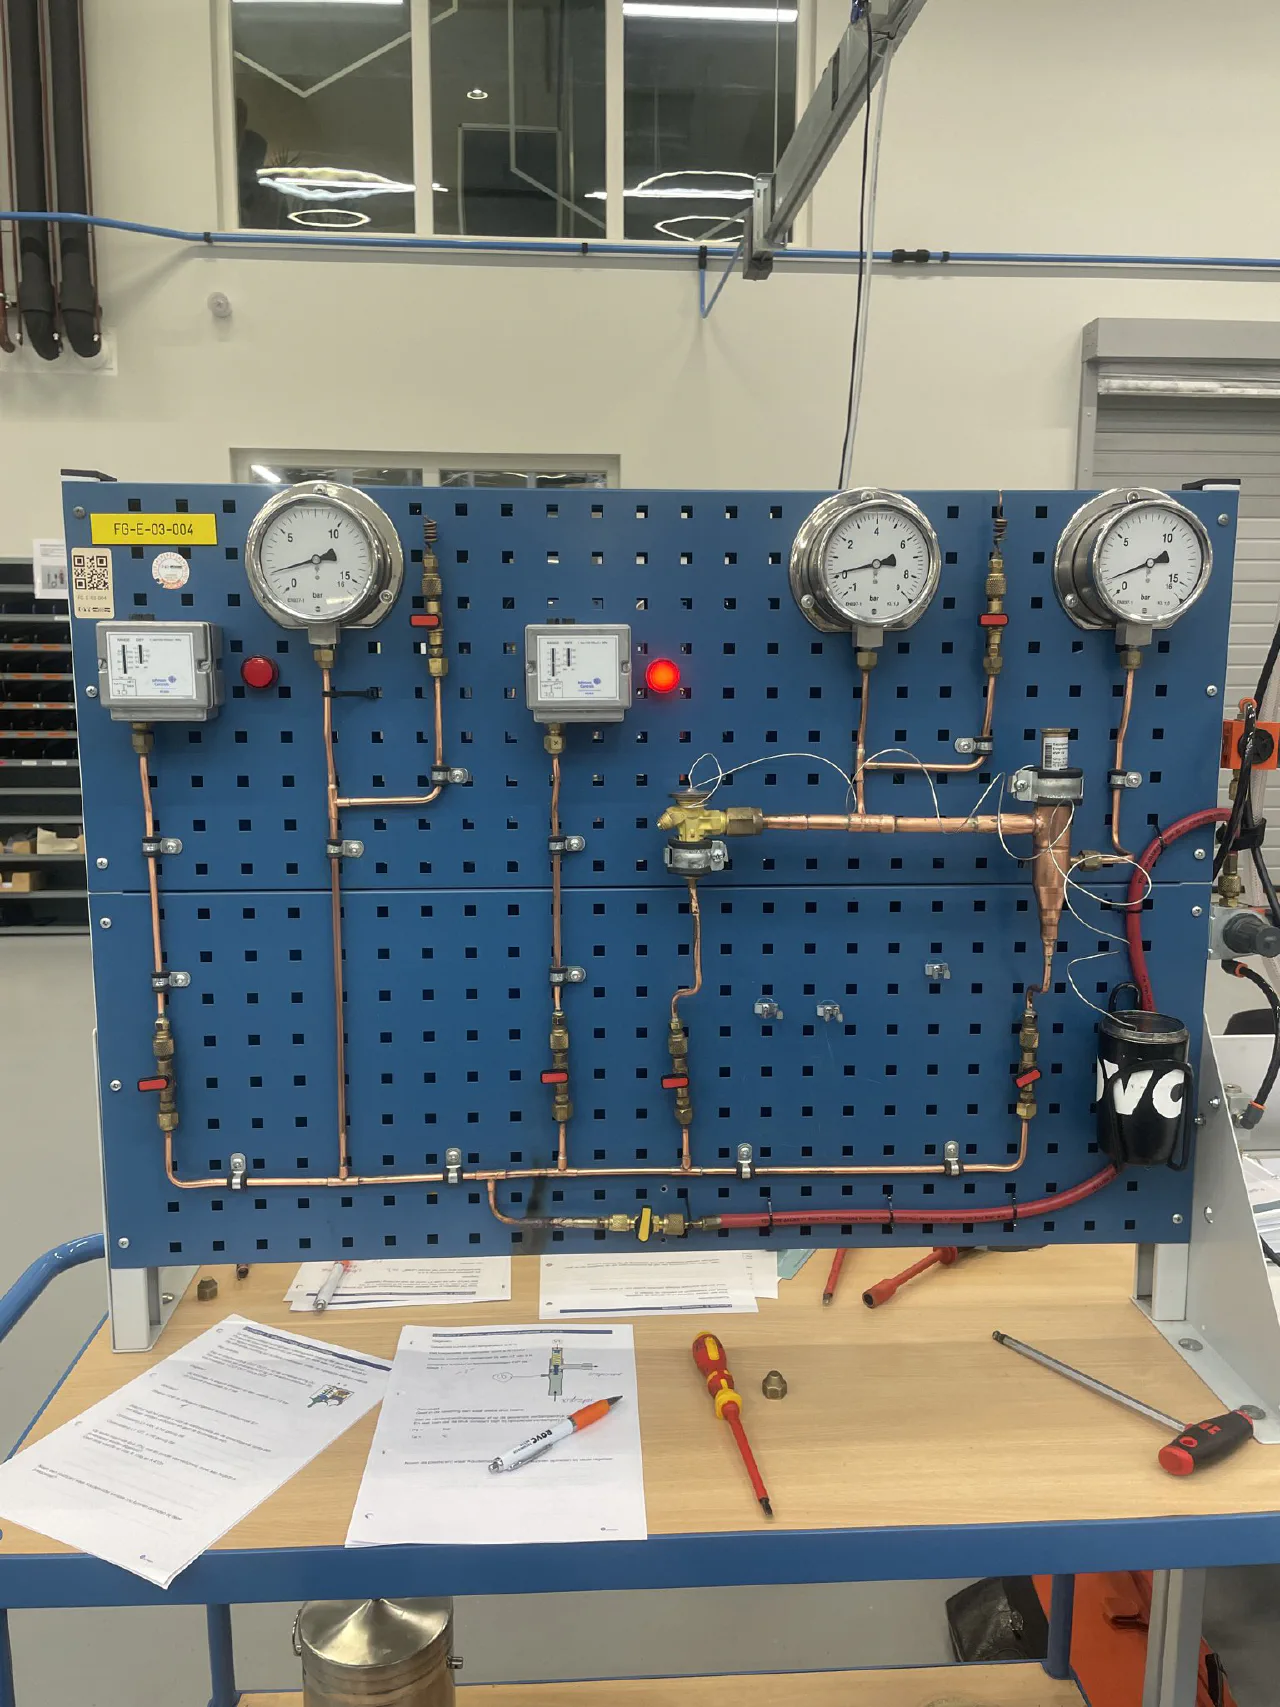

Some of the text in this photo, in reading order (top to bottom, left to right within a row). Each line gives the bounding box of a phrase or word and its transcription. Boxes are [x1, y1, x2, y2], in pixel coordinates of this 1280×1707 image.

[113, 522, 194, 536] FG-E-03-004
[874, 528, 879, 536] 4
[288, 533, 294, 543] 5
[329, 529, 339, 539] 10
[1163, 534, 1173, 543] 10
[848, 540, 854, 549] 2
[901, 540, 906, 549] 6
[1124, 538, 1129, 547] 5
[341, 571, 350, 581] 15
[842, 571, 848, 580] 0
[904, 570, 909, 579] 8
[1169, 574, 1179, 583] 15
[292, 579, 297, 588] 0
[849, 583, 857, 592] -1
[1122, 582, 1128, 590] 0
